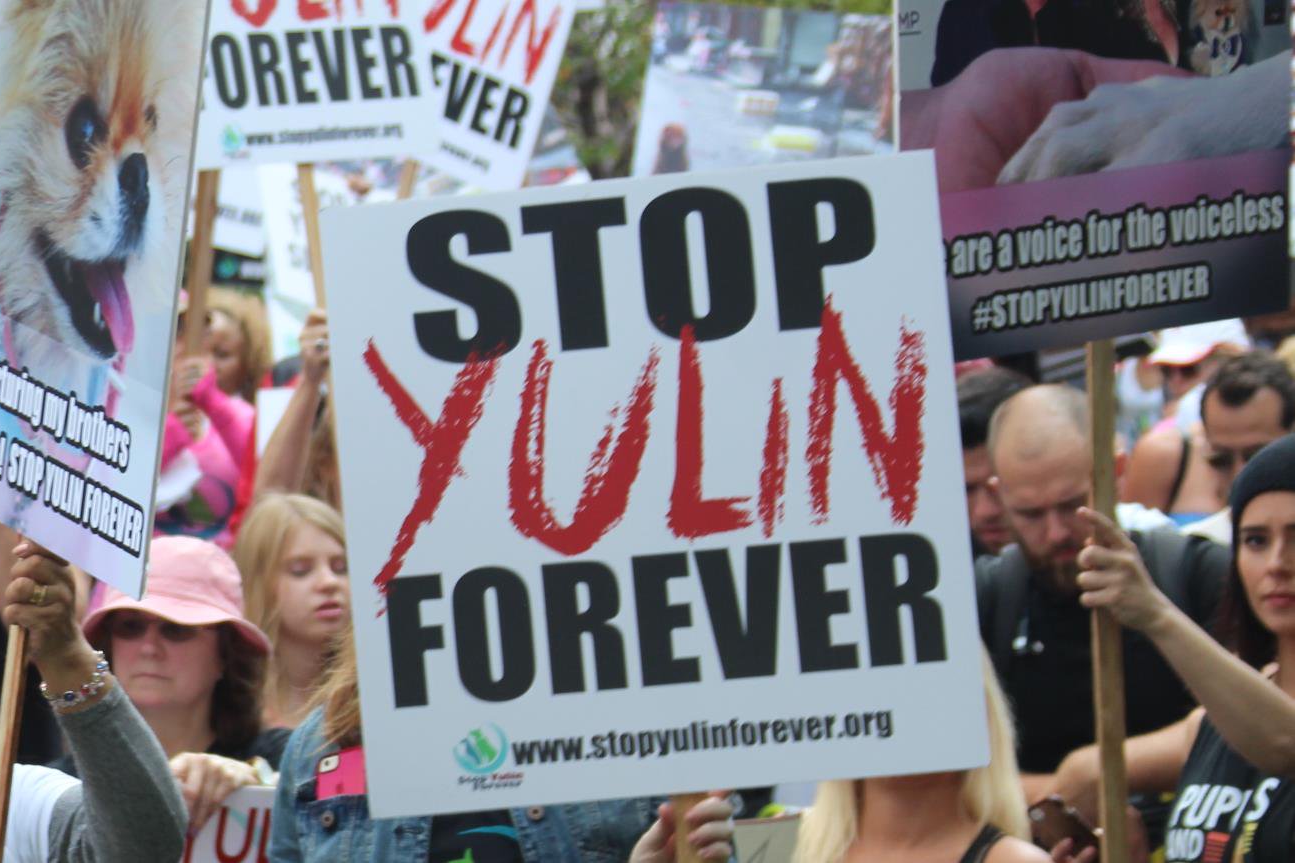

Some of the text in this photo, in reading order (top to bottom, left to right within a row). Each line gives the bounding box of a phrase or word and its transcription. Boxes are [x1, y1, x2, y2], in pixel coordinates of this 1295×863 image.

[203, 25, 421, 109] OREVER
[406, 177, 877, 364] STOP
[951, 193, 1286, 276] are a voice for the voiceless
[972, 264, 1211, 332] #STOPYULINFOREVER
[43, 386, 69, 443] my
[65, 391, 131, 473] brothers
[362, 293, 928, 618] YULIN
[7, 438, 45, 500] STOP
[43, 456, 86, 524] YULIN
[83, 477, 145, 558] FOREVER
[386, 532, 949, 709] FOREVER
[512, 709, 894, 766] www.stopyulinforever.org
